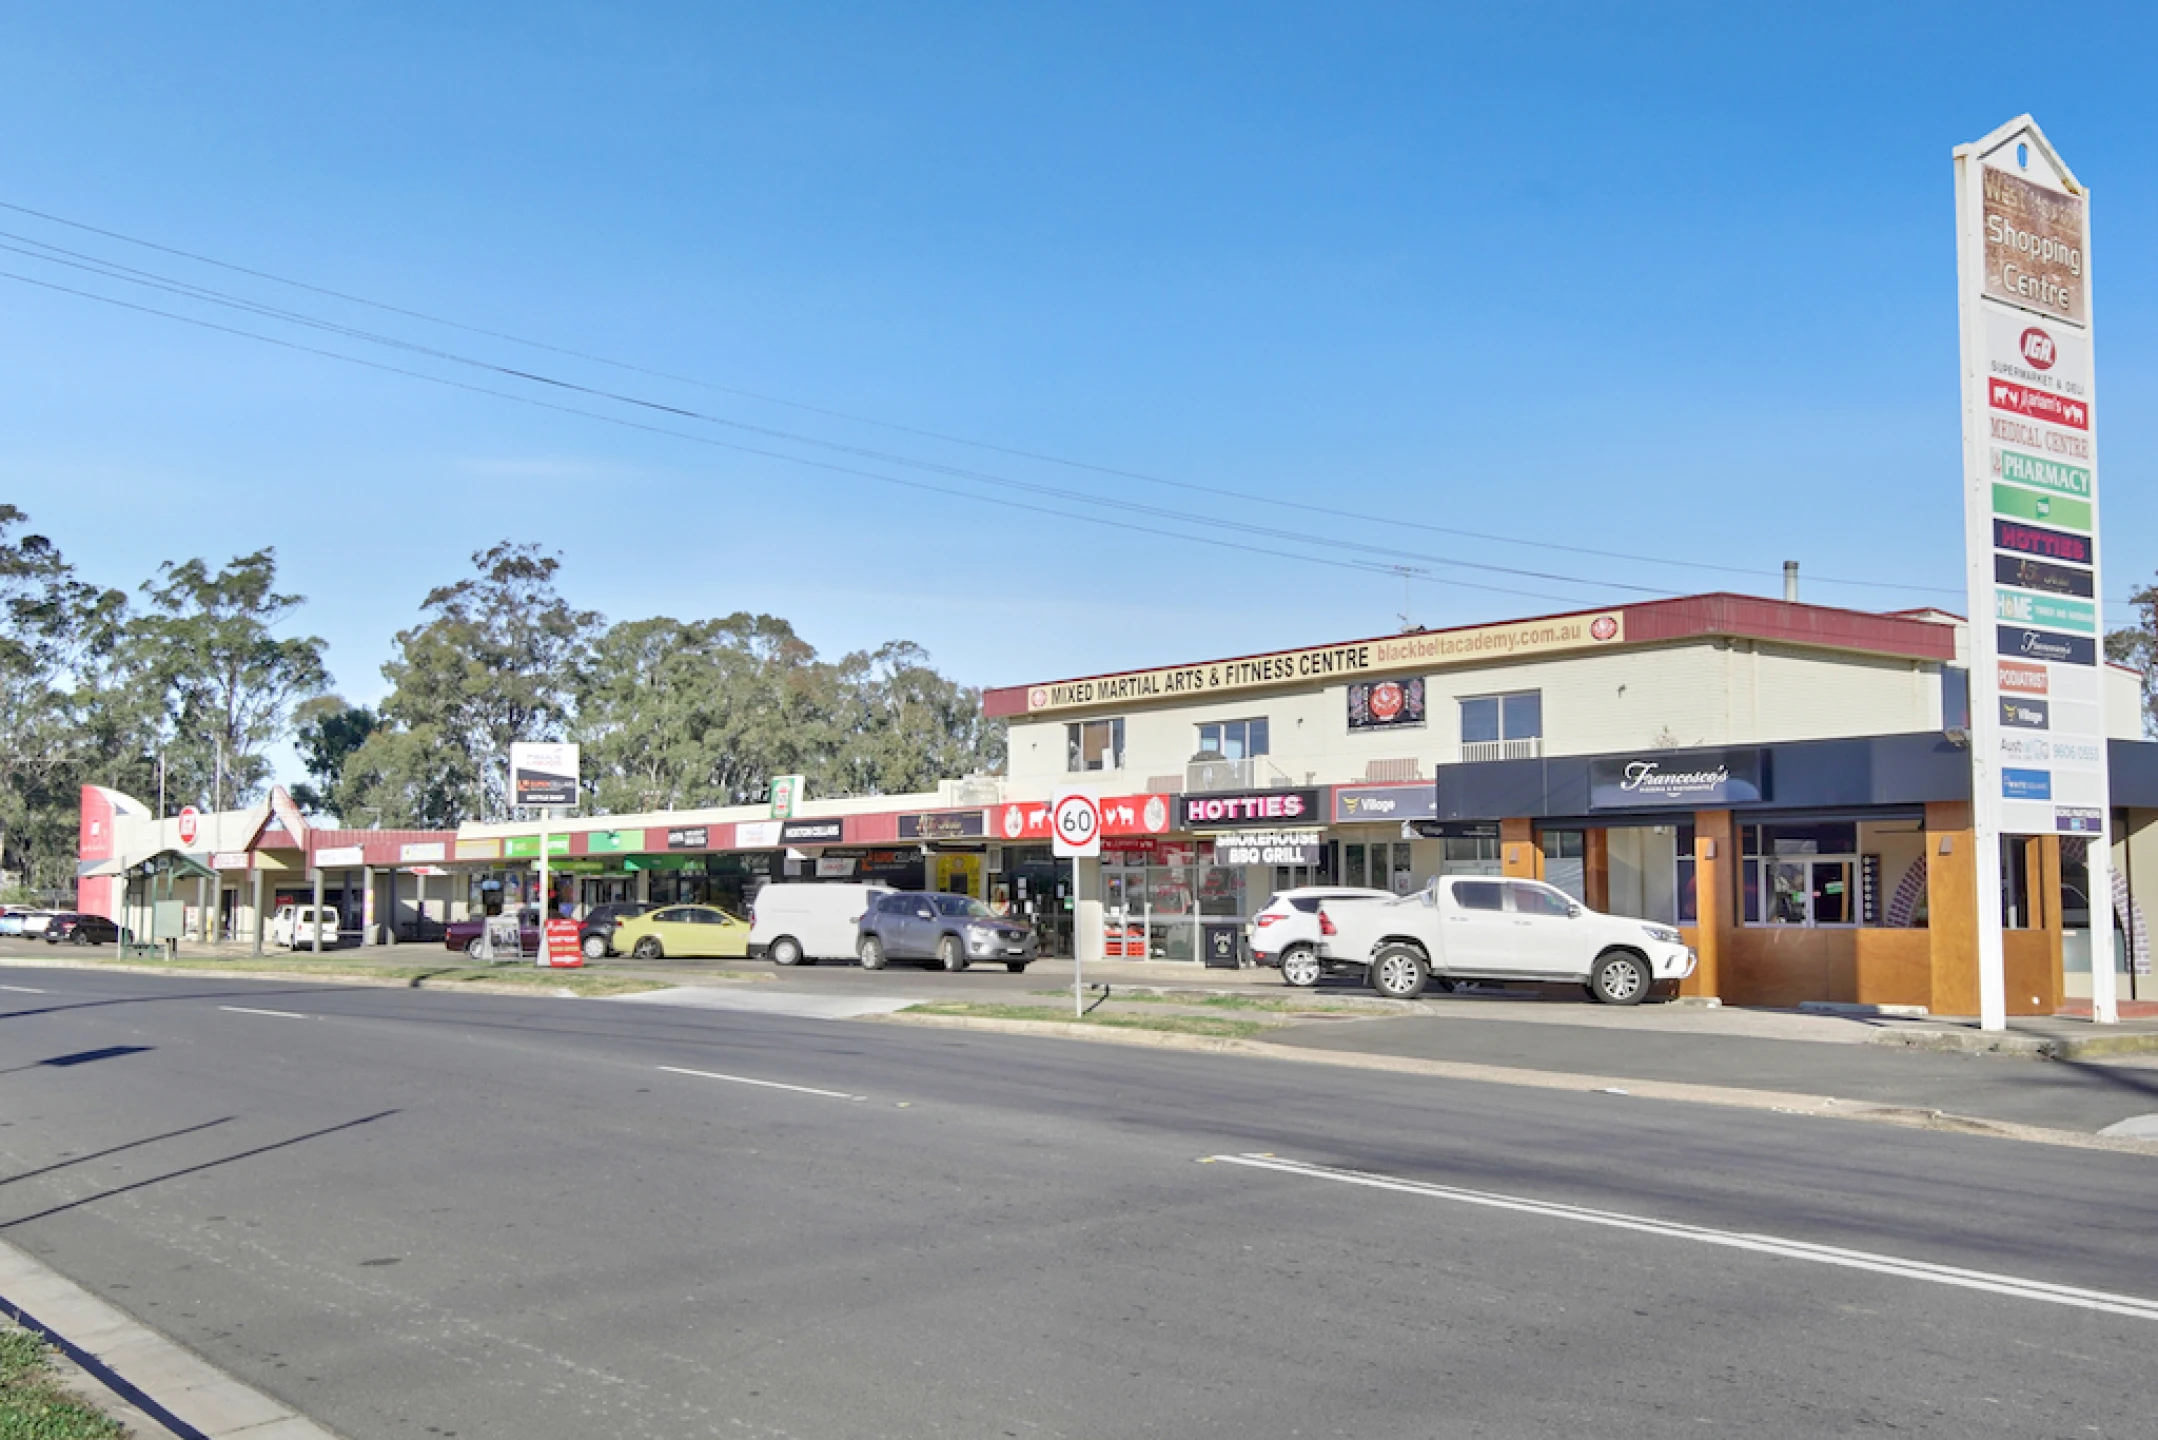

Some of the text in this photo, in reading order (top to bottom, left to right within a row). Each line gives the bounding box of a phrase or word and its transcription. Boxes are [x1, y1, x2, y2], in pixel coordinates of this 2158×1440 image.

[1987, 214, 2081, 276] Shopping
[2003, 263, 2069, 309] Centre
[1991, 360, 2053, 387] SUPERMARKET
[1991, 417, 2088, 460] MEDICAL CENTRE
[2004, 454, 2089, 492] PHARMACY
[2002, 526, 2085, 559] HOTTIES
[1051, 624, 1582, 705] MIXED MARTIAL ARTS & FITNESS CENTRE blackbeltacademy.com.au
[1620, 761, 1729, 792] Francesco's
[1063, 809, 1091, 832] 60
[1188, 795, 1305, 821] HOTTIES
[1361, 798, 1396, 813] Village
[1229, 846, 1305, 864] BBQ GRILL
